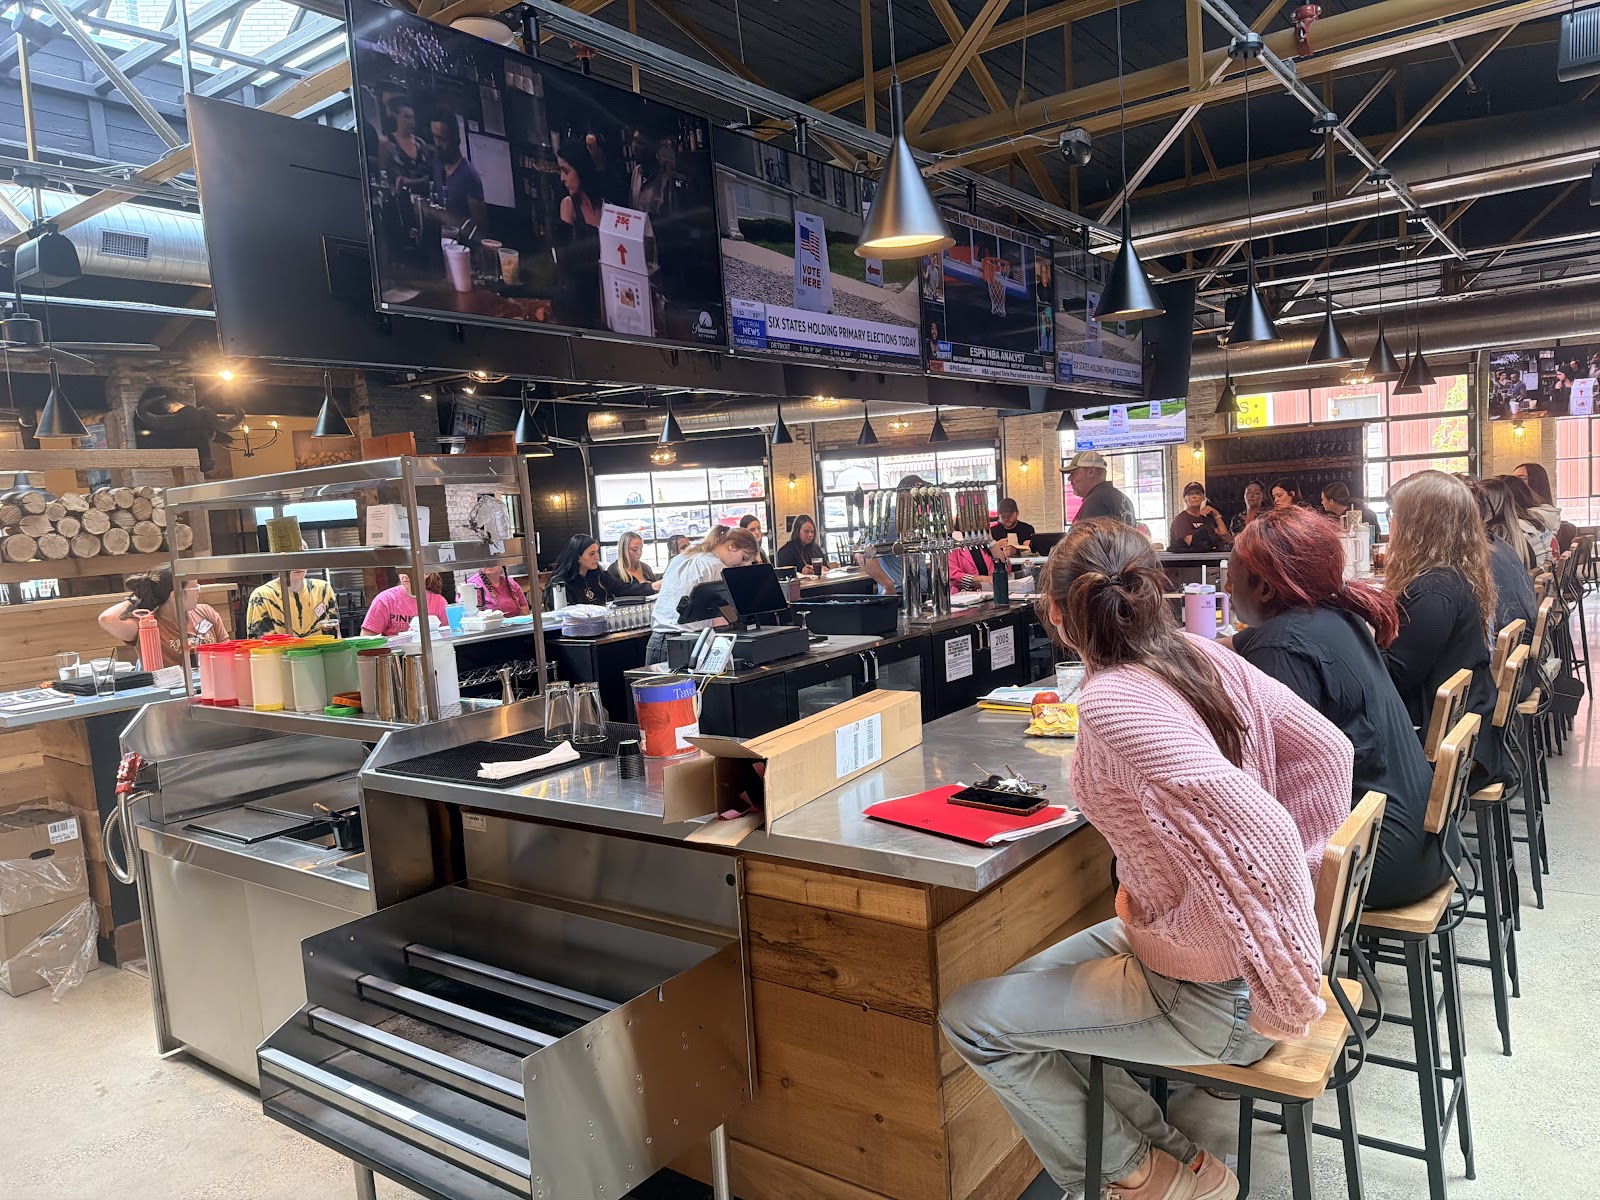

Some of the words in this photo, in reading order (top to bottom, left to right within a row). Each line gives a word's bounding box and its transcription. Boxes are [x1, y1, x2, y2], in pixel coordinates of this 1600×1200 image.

[802, 264, 821, 278] VOTE
[802, 276, 821, 289] HERE
[737, 320, 760, 328] SPECTRUM
[742, 326, 760, 337] NEWS
[768, 315, 780, 330] SIX
[782, 318, 806, 333] STATES
[807, 322, 838, 338] HOLDING
[838, 326, 866, 341] PRIMARY
[867, 331, 898, 346] ELECTIONS
[898, 336, 917, 348] TODAY
[735, 338, 759, 346] WEATHER
[770, 342, 791, 350] DETROIT
[969, 346, 987, 359] ESPN
[987, 349, 1000, 361] NBA
[1000, 351, 1026, 364] ANALYST
[1079, 361, 1090, 372] STATES
[1090, 364, 1104, 374] HOLDING
[1117, 368, 1131, 378] ELECTIONS
